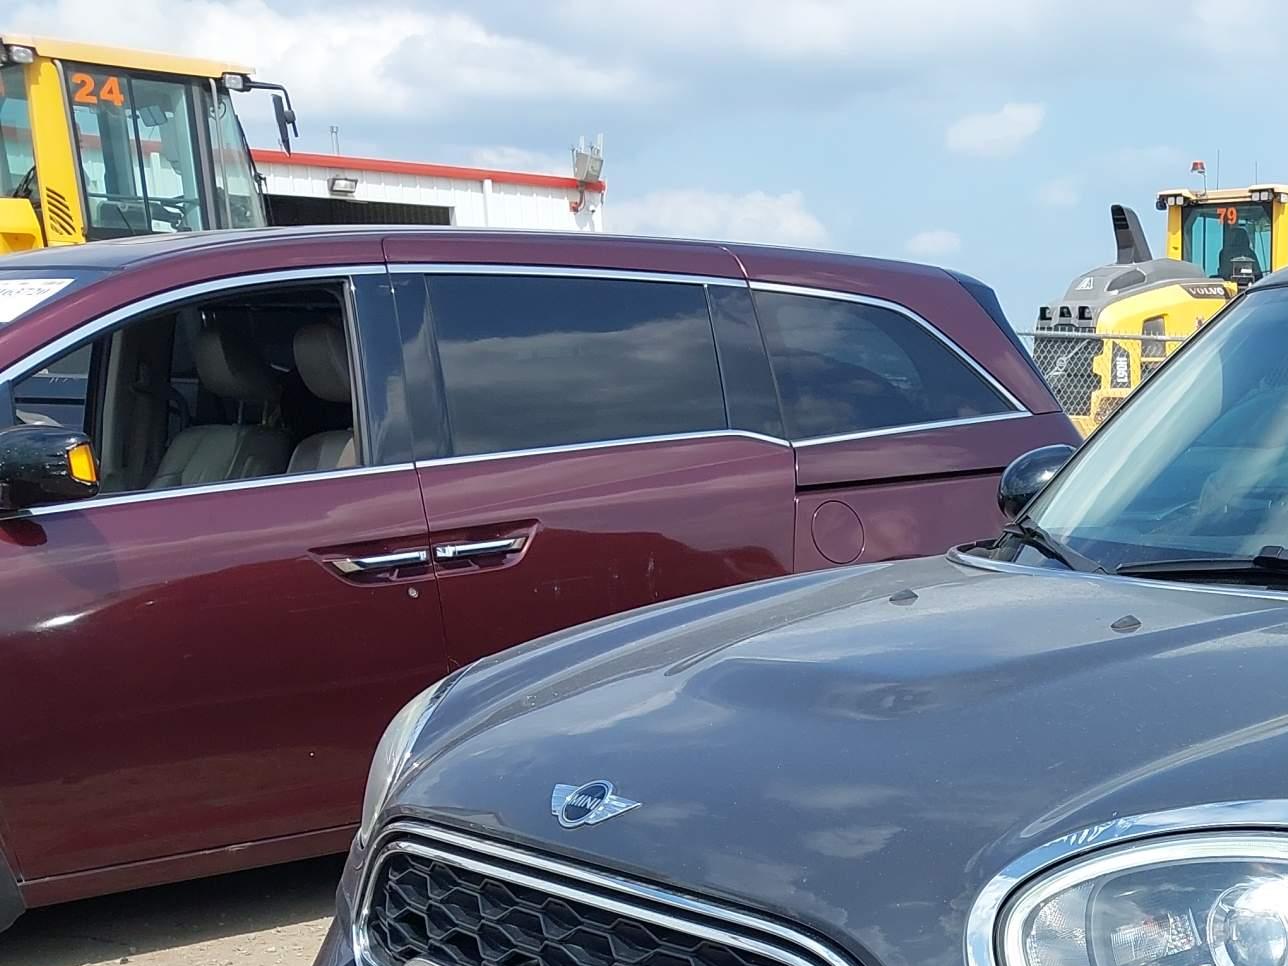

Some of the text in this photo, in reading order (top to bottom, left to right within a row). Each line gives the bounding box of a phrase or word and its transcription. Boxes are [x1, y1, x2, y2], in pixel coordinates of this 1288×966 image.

[71, 73, 124, 106] 24
[1216, 207, 1238, 224] 79
[1189, 286, 1225, 295] VOLVO
[567, 794, 601, 811] MINI
